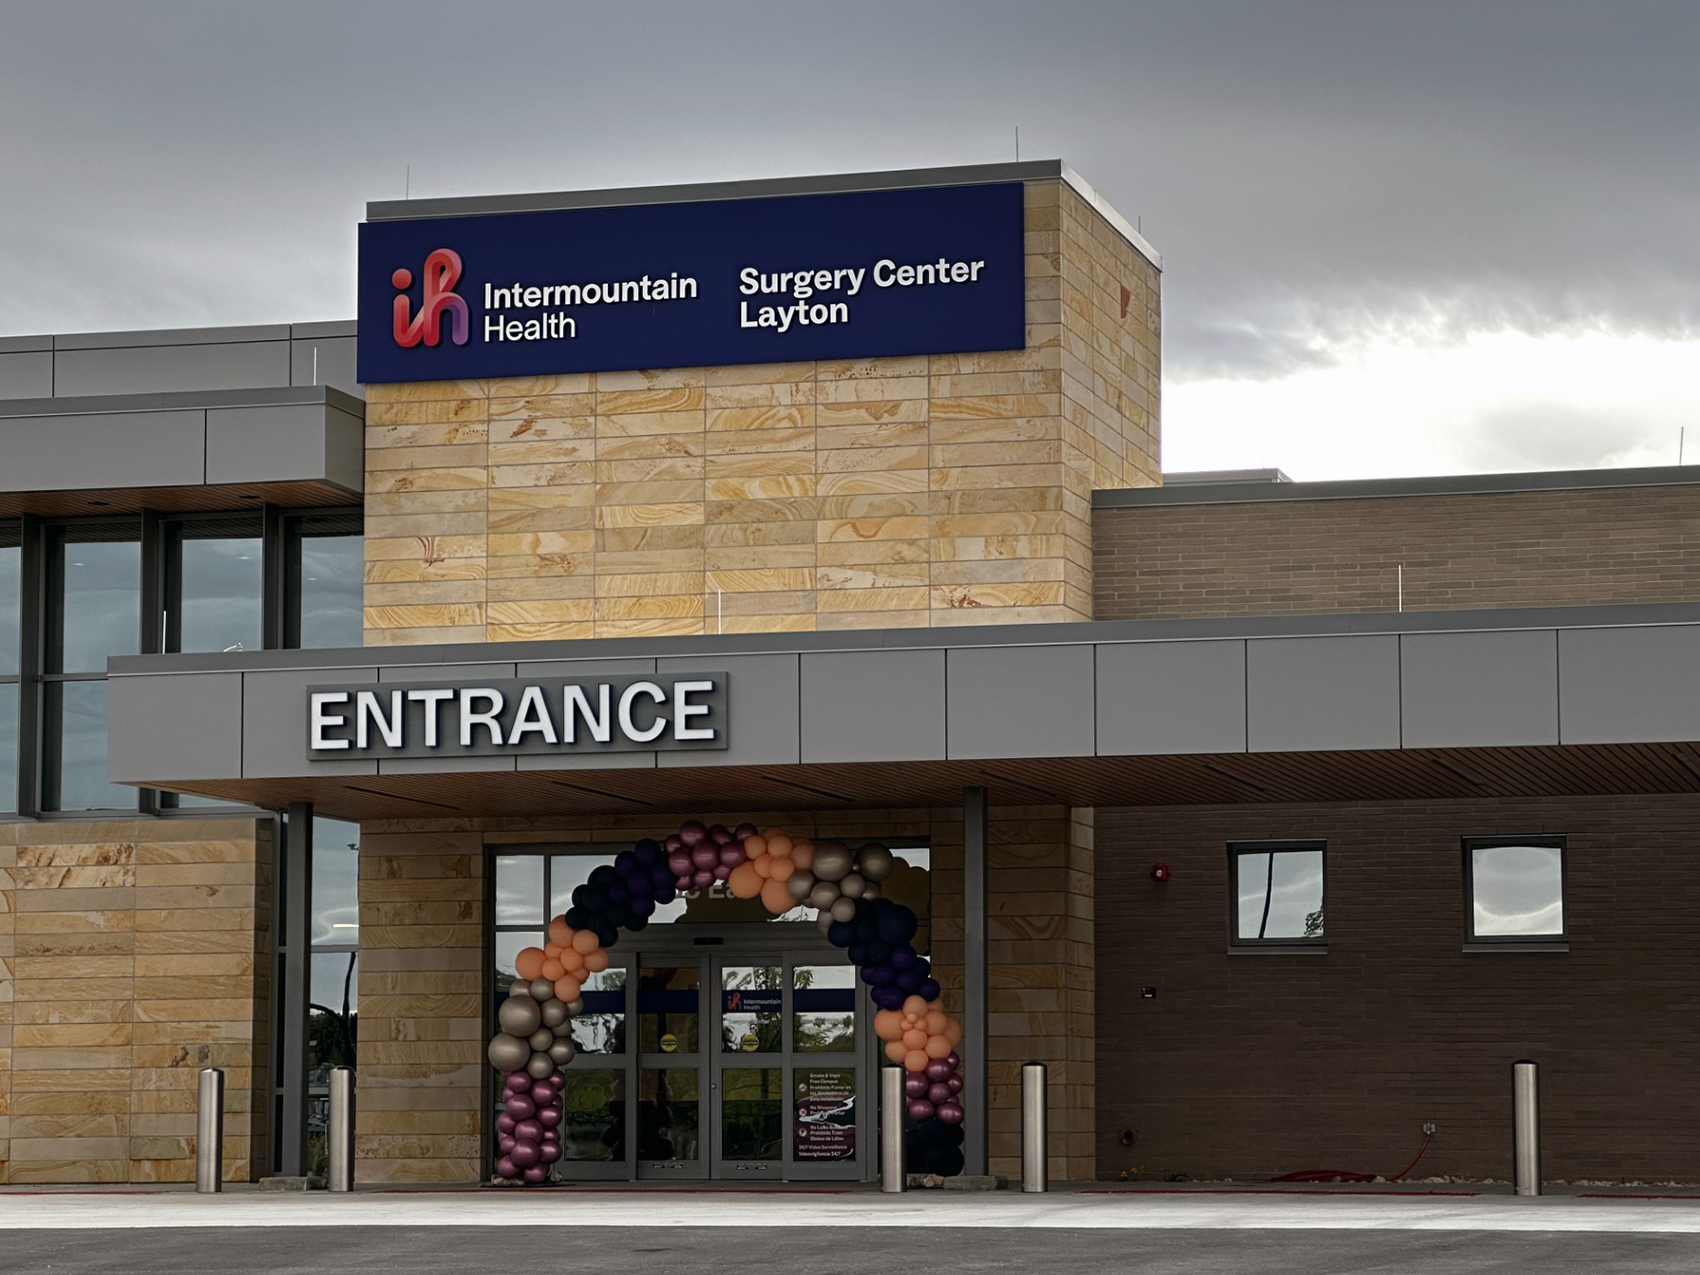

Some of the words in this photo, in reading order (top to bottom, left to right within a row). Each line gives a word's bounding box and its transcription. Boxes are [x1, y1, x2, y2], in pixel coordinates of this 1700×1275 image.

[484, 272, 697, 311] Intermountain
[739, 265, 865, 302] Surgery
[873, 257, 985, 288] Center
[484, 312, 576, 342] Health
[739, 299, 849, 333] Layton
[310, 679, 716, 750] ENTRANCE
